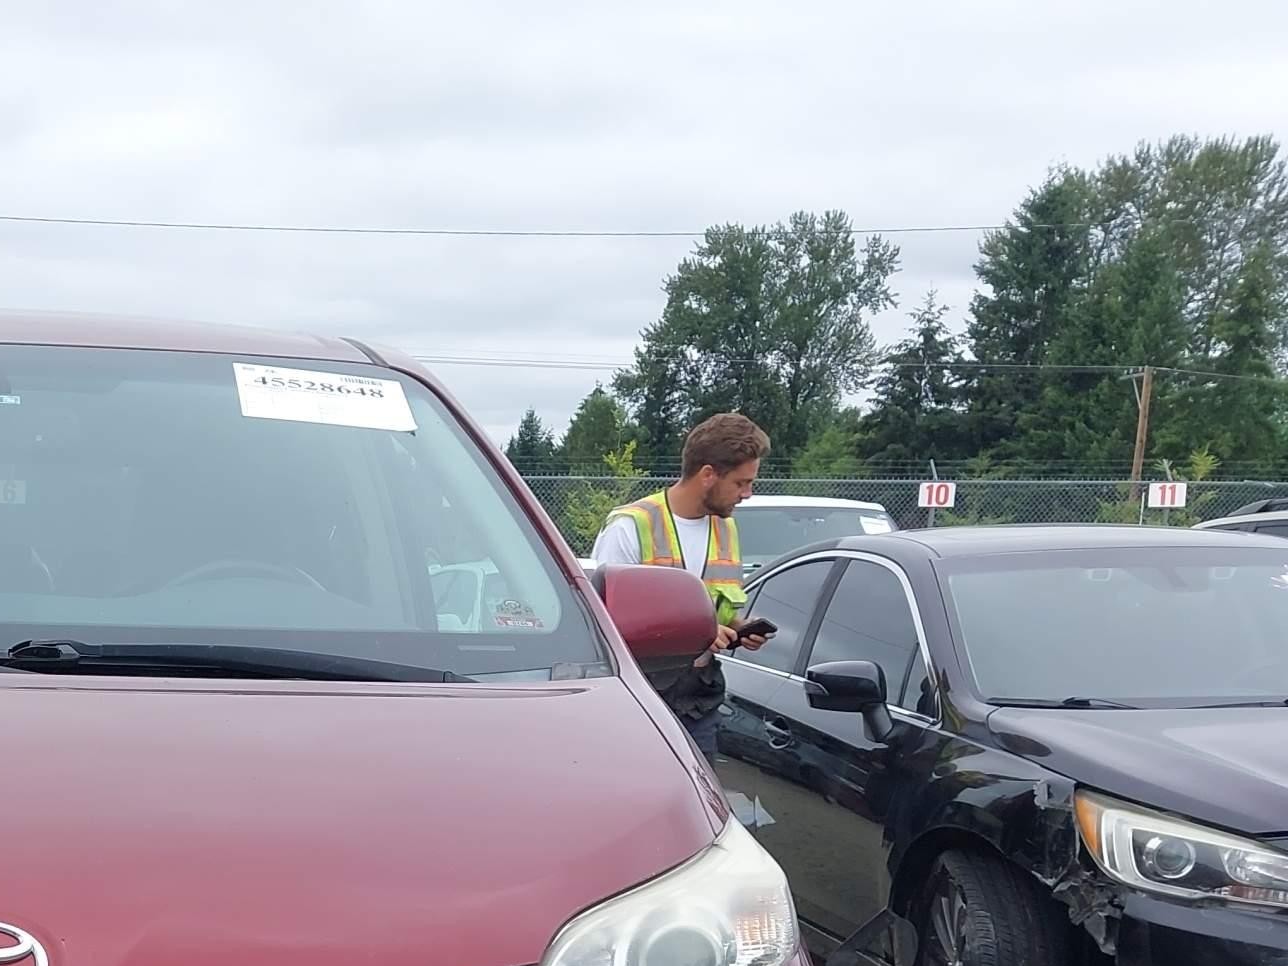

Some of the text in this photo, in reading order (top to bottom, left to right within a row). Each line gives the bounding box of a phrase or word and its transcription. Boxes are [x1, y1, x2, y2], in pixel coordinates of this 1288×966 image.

[253, 375, 385, 399] 45528648
[926, 484, 950, 505] 10
[1159, 484, 1177, 506] 11
